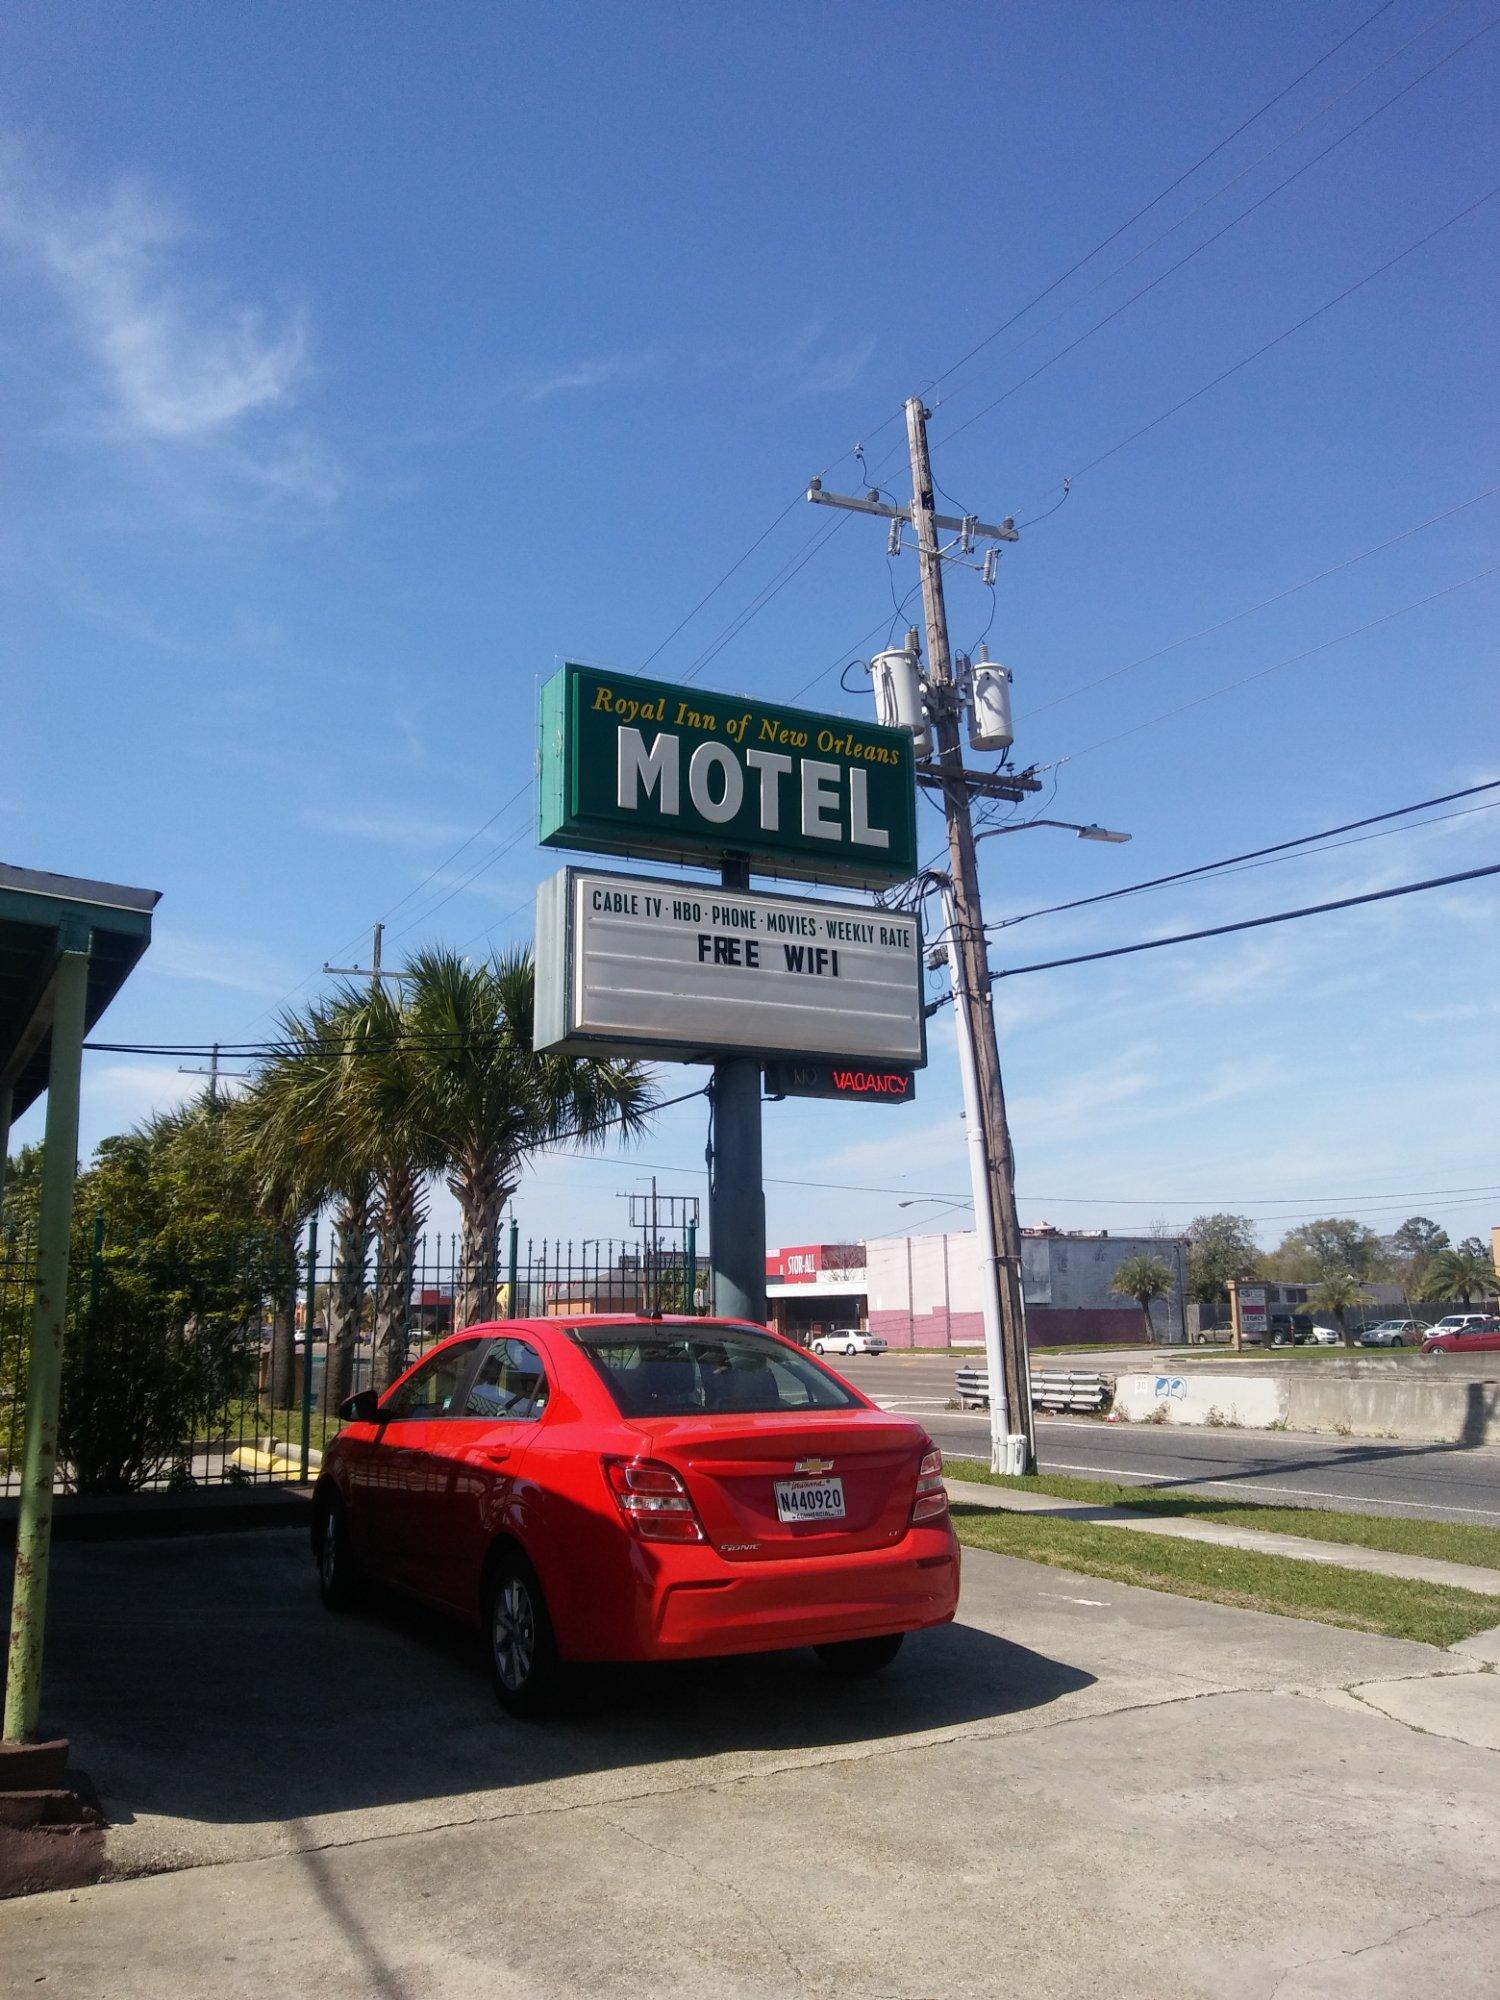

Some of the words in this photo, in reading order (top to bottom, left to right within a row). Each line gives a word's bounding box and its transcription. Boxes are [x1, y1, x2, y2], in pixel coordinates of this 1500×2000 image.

[592, 687, 665, 722] Royal
[674, 703, 717, 731] Inn
[726, 714, 752, 743] of
[759, 719, 808, 748] New
[818, 730, 900, 765] Orleans
[617, 725, 889, 848] MOTEL
[593, 890, 638, 915] CABLE
[645, 897, 662, 917] TV
[673, 901, 701, 922] HBO
[712, 906, 757, 929] PHONE
[767, 913, 816, 936] MOVIES
[826, 920, 874, 943] WEEKLY
[880, 927, 910, 948] RATE
[698, 934, 760, 968] FREE
[784, 944, 838, 976] WIFI
[832, 1070, 908, 1093] VACANCY
[787, 1254, 816, 1274] STOR-ALL
[780, 1489, 842, 1512] N440920
